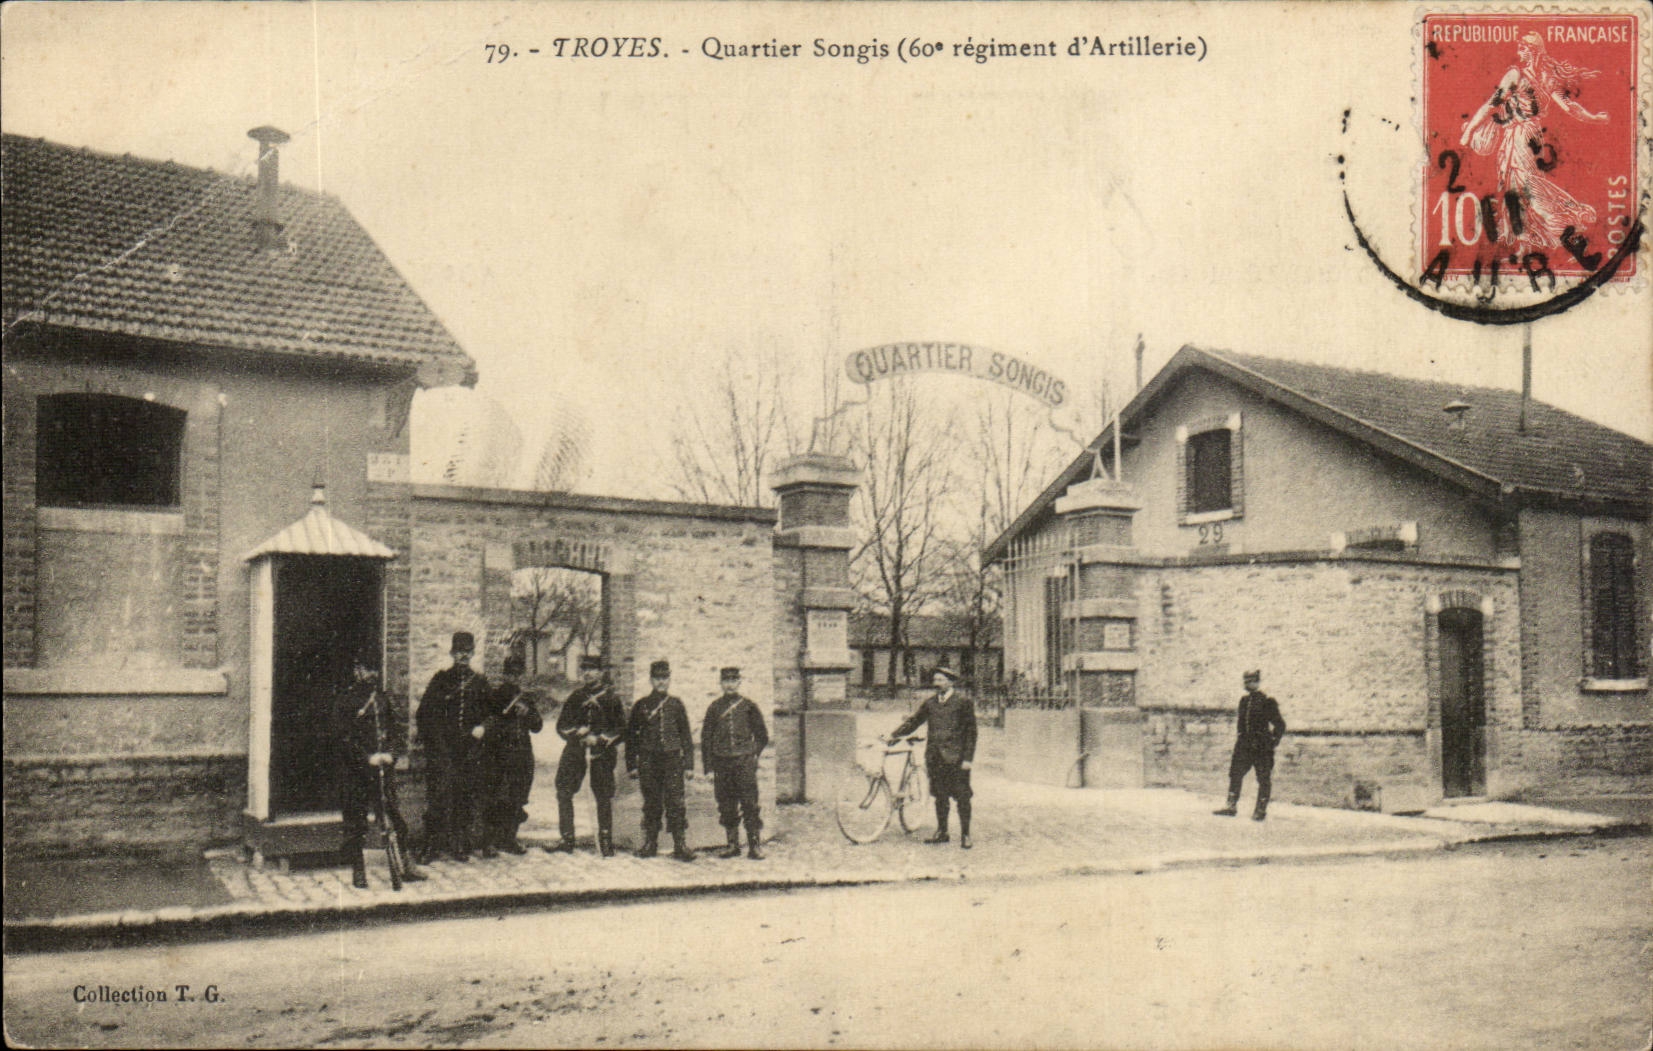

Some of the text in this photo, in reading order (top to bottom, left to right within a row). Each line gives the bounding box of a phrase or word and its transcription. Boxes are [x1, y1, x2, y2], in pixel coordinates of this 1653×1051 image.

[1547, 25, 1629, 45] FRANÇAISE
[1433, 192, 1483, 246] 10
[855, 343, 1066, 407] QUARTIER SONGIS
[1198, 522, 1224, 545] 29
